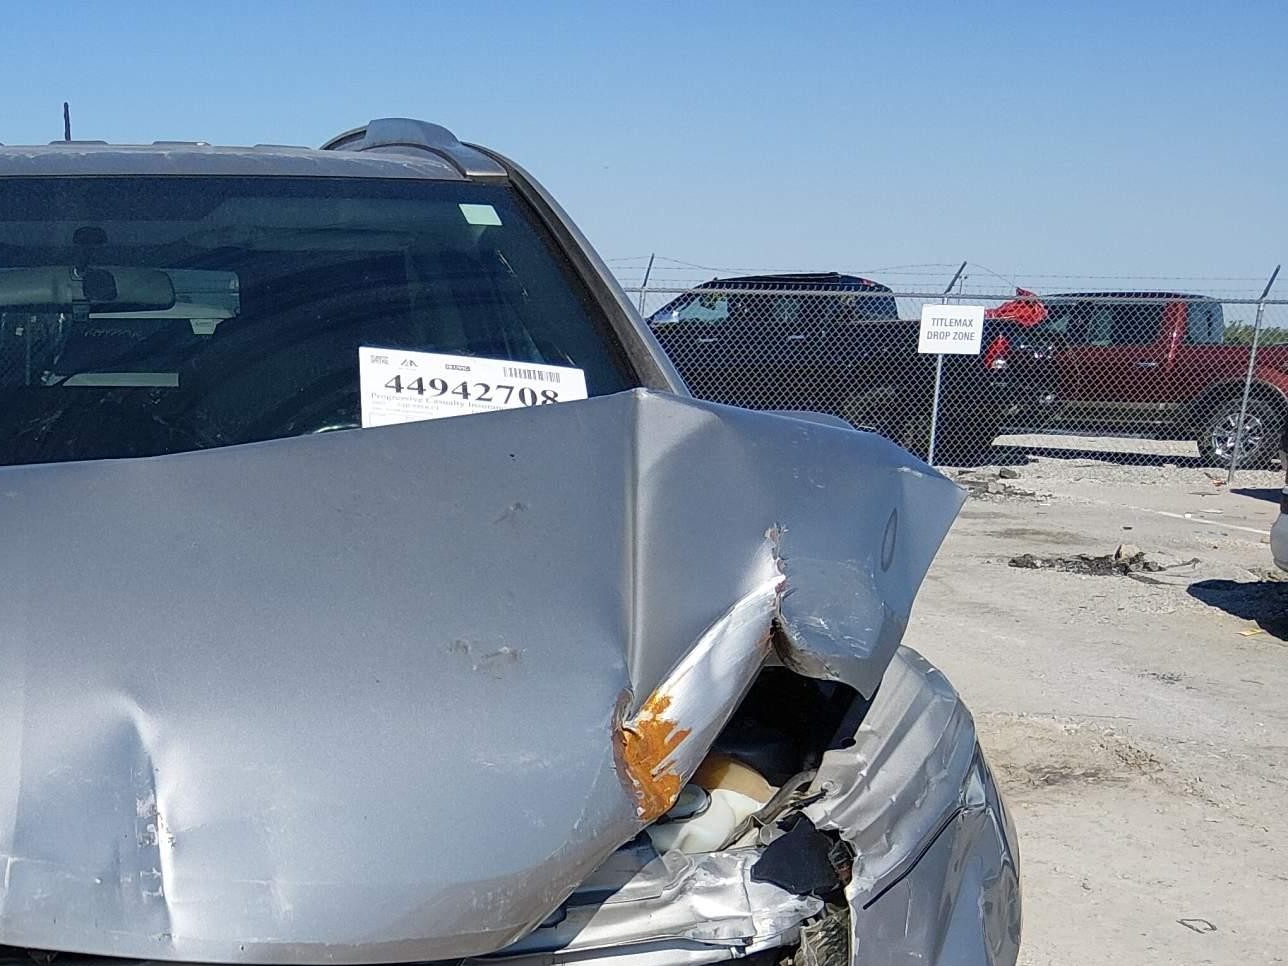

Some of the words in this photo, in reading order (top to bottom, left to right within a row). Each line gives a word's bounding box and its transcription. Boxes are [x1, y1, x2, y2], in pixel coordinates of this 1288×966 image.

[931, 317, 974, 328] TITLEMAX
[926, 331, 951, 341] DROP
[952, 331, 976, 341] ZONE
[384, 374, 559, 407] 44942708
